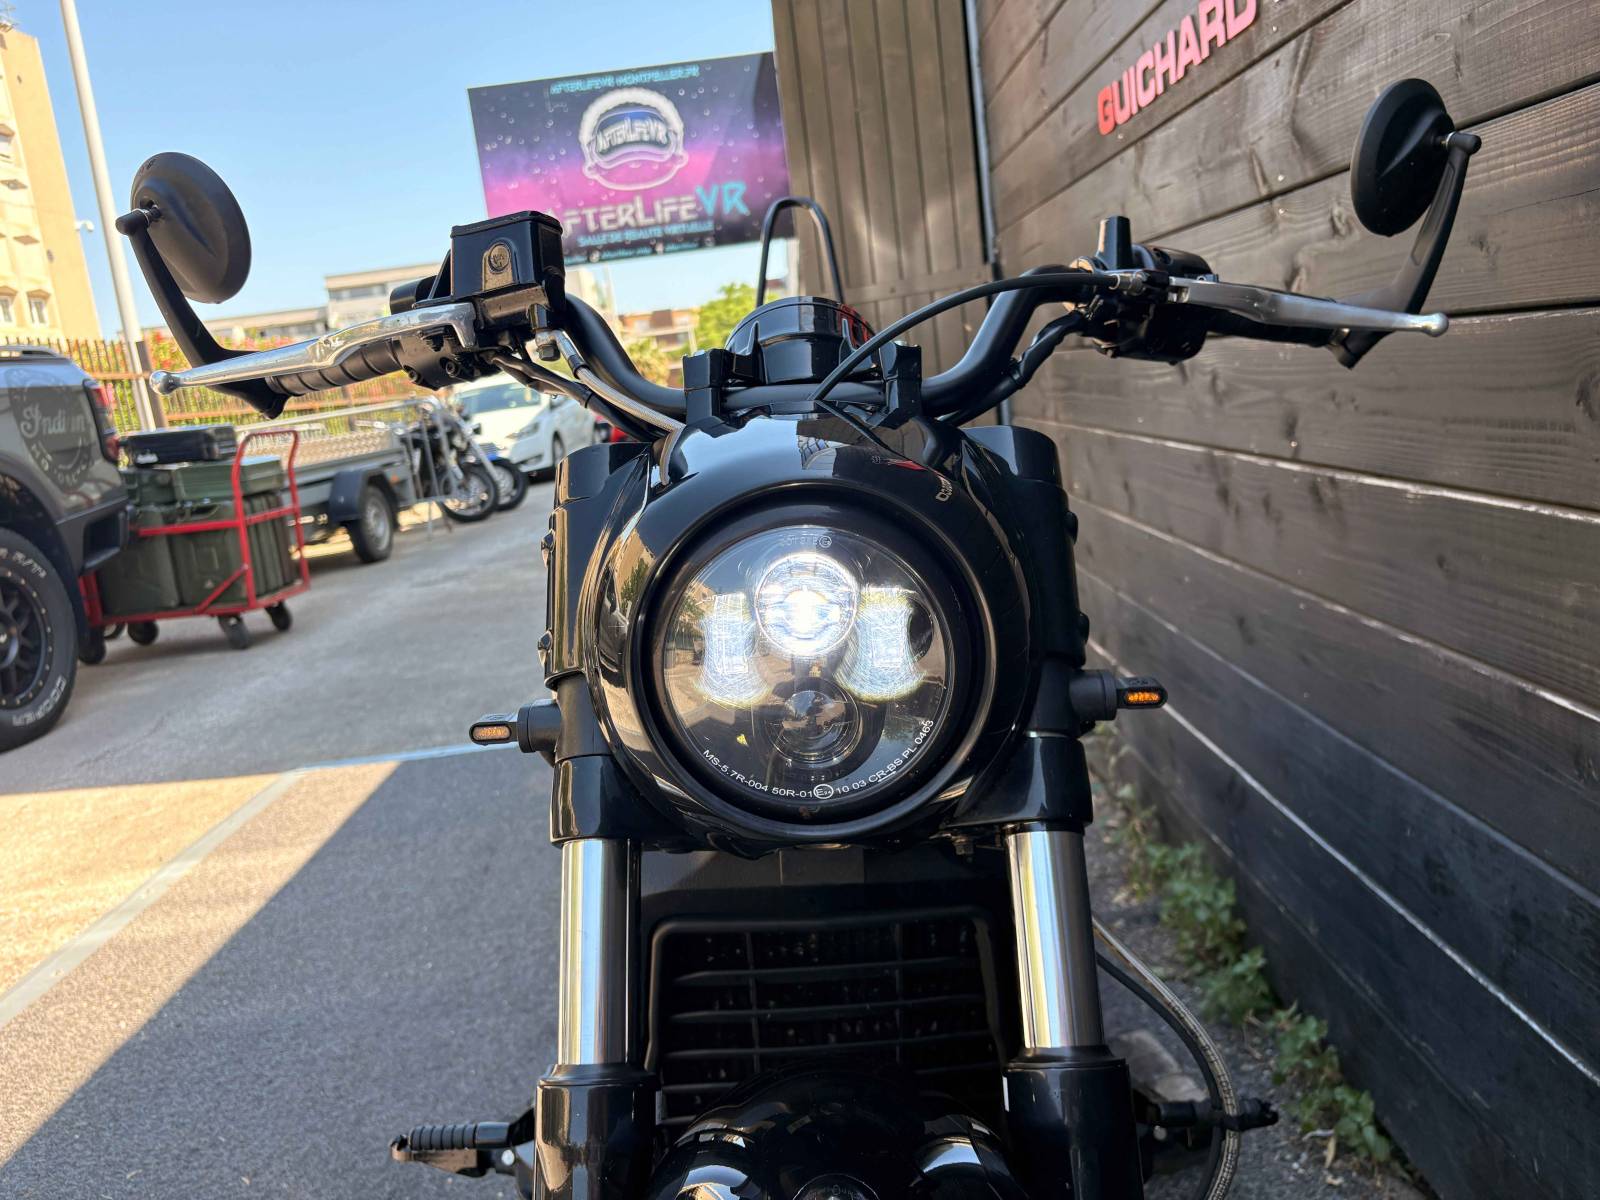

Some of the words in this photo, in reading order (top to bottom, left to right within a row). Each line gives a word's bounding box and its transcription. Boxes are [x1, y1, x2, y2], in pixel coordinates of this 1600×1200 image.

[1098, 0, 1257, 135] GUICHARD
[703, 749, 769, 792] MS-5.7R-004
[771, 786, 813, 798] 50R-01
[836, 785, 850, 794] 10
[852, 779, 867, 790] 03
[868, 758, 903, 781] CR-BS
[902, 746, 917, 759] PL
